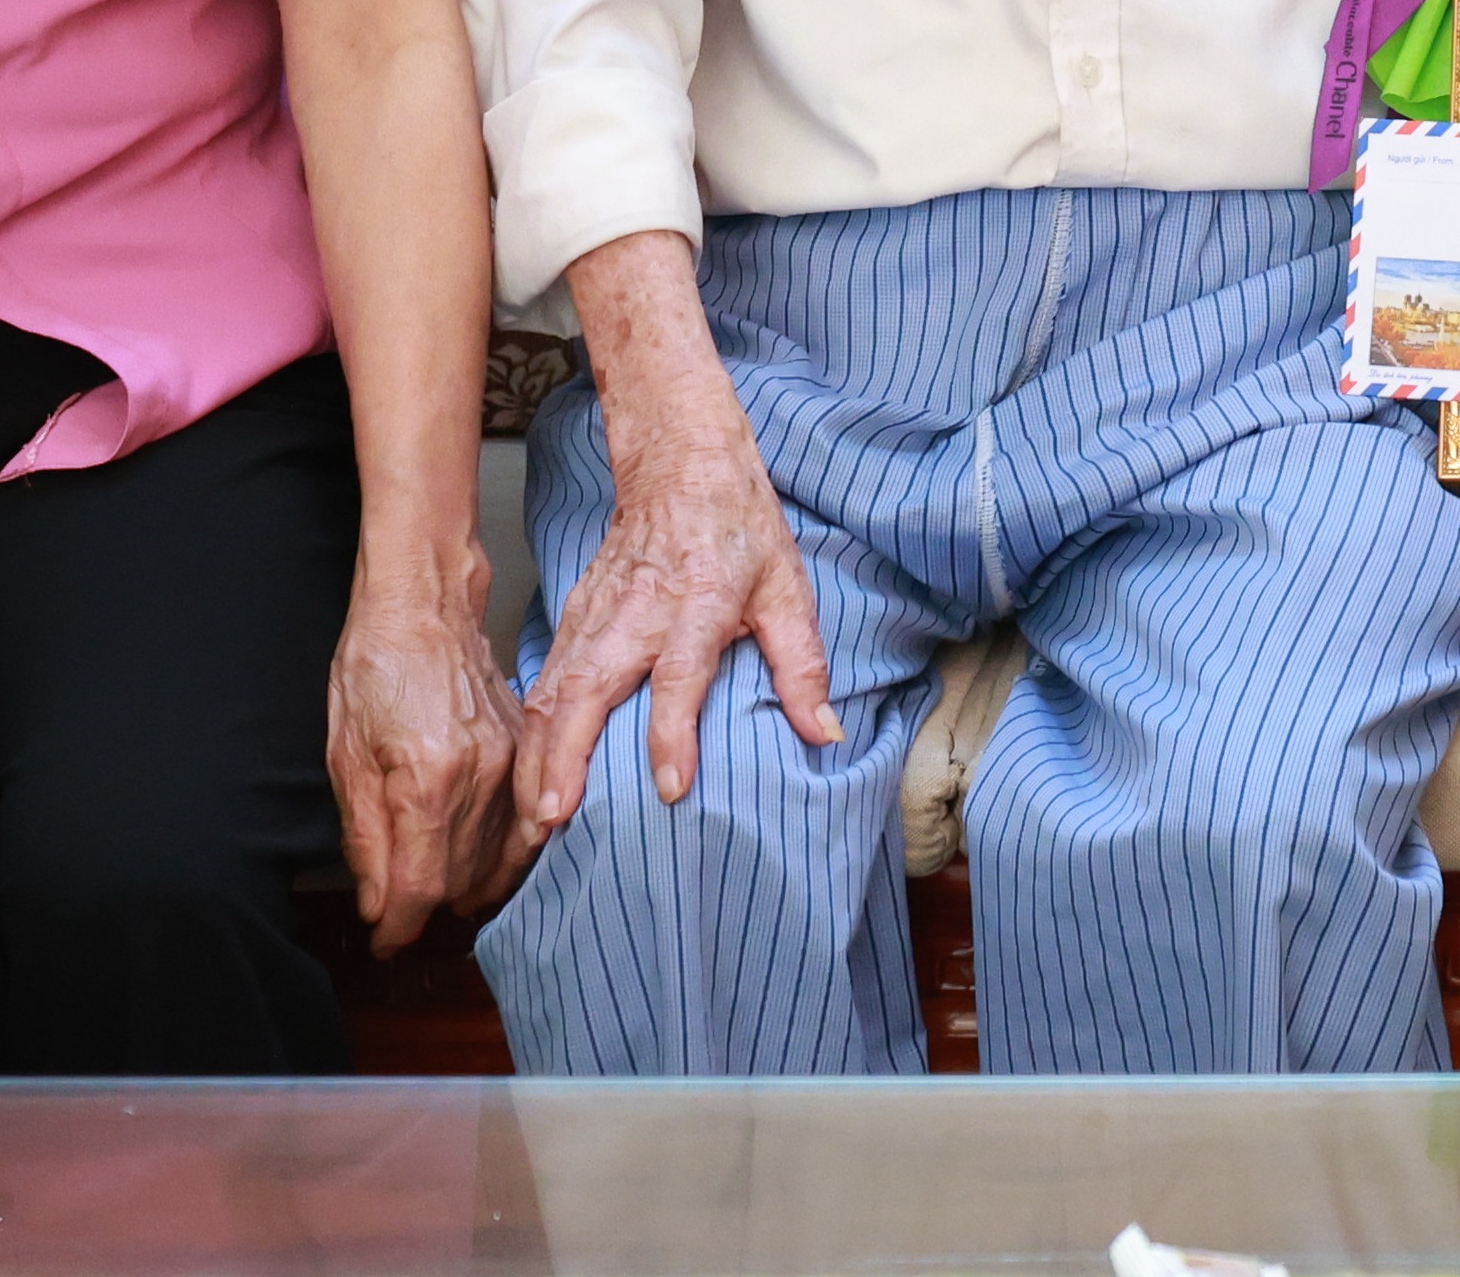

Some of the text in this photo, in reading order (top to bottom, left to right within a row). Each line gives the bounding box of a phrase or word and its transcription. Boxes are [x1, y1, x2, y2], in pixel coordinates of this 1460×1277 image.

[1324, 60, 1357, 139] Chanel
[1387, 153, 1413, 166] Người
[1432, 155, 1454, 166] From
